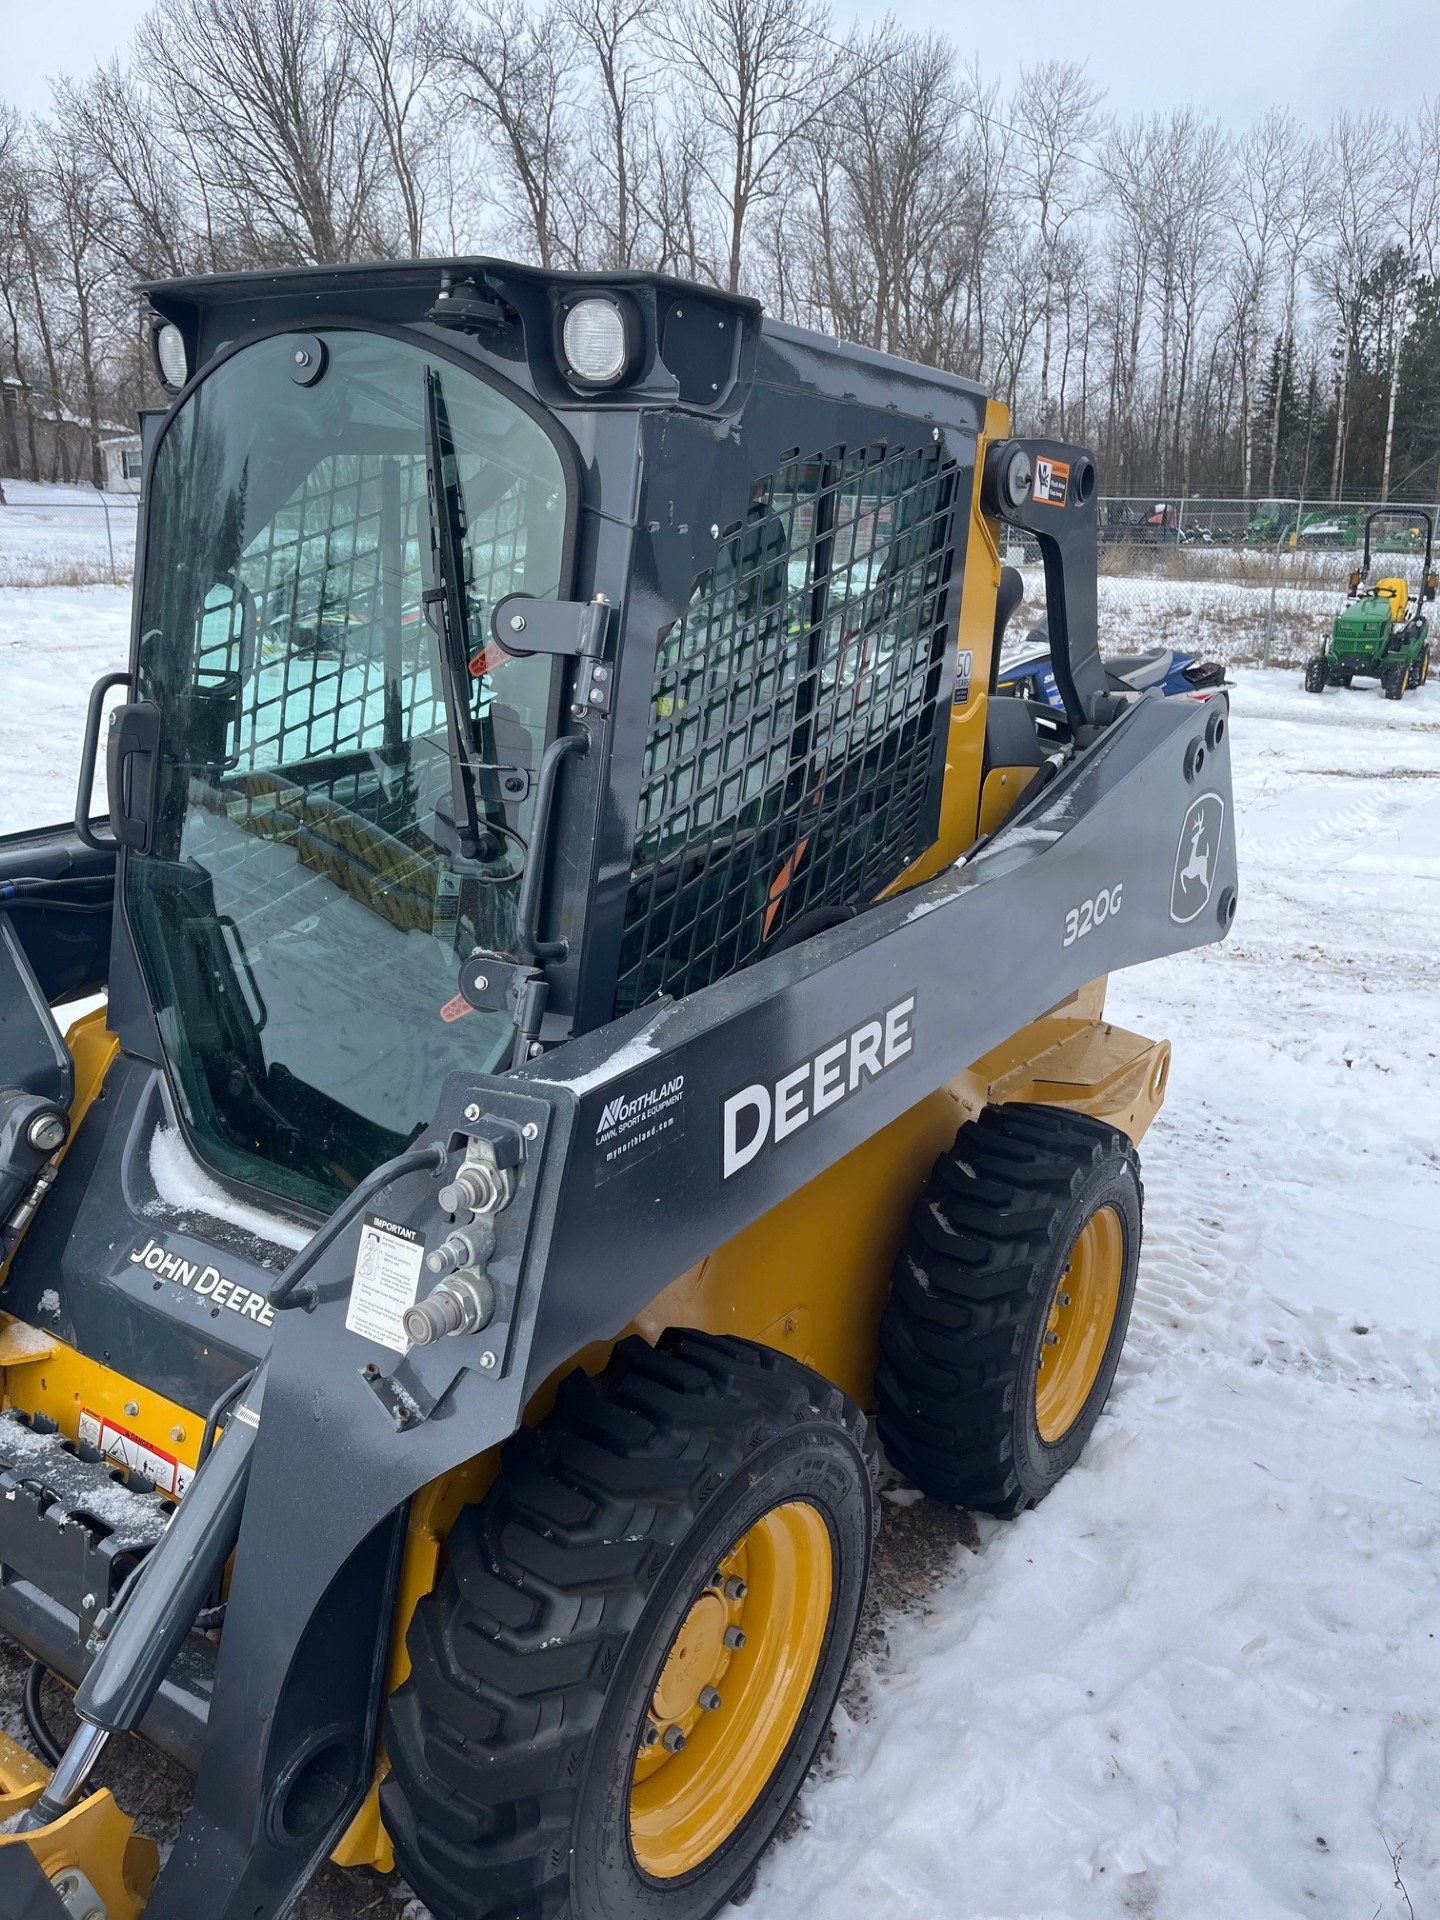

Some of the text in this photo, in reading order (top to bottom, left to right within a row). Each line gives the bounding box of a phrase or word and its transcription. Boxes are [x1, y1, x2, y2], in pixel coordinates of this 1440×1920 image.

[955, 678, 970, 688] YEARS
[956, 652, 972, 679] 50
[1063, 882, 1123, 947] 320G
[596, 1075, 684, 1134] NORTHLAND
[723, 995, 915, 1180] DEERE
[595, 1091, 684, 1146] LAWN, SPORT & EQUIPMENT
[606, 1117, 674, 1162] mynorthland.com
[373, 1216, 417, 1241] IMPORTANT
[129, 1239, 279, 1328] JOHN DEERE
[130, 1433, 154, 1450] DANGER
